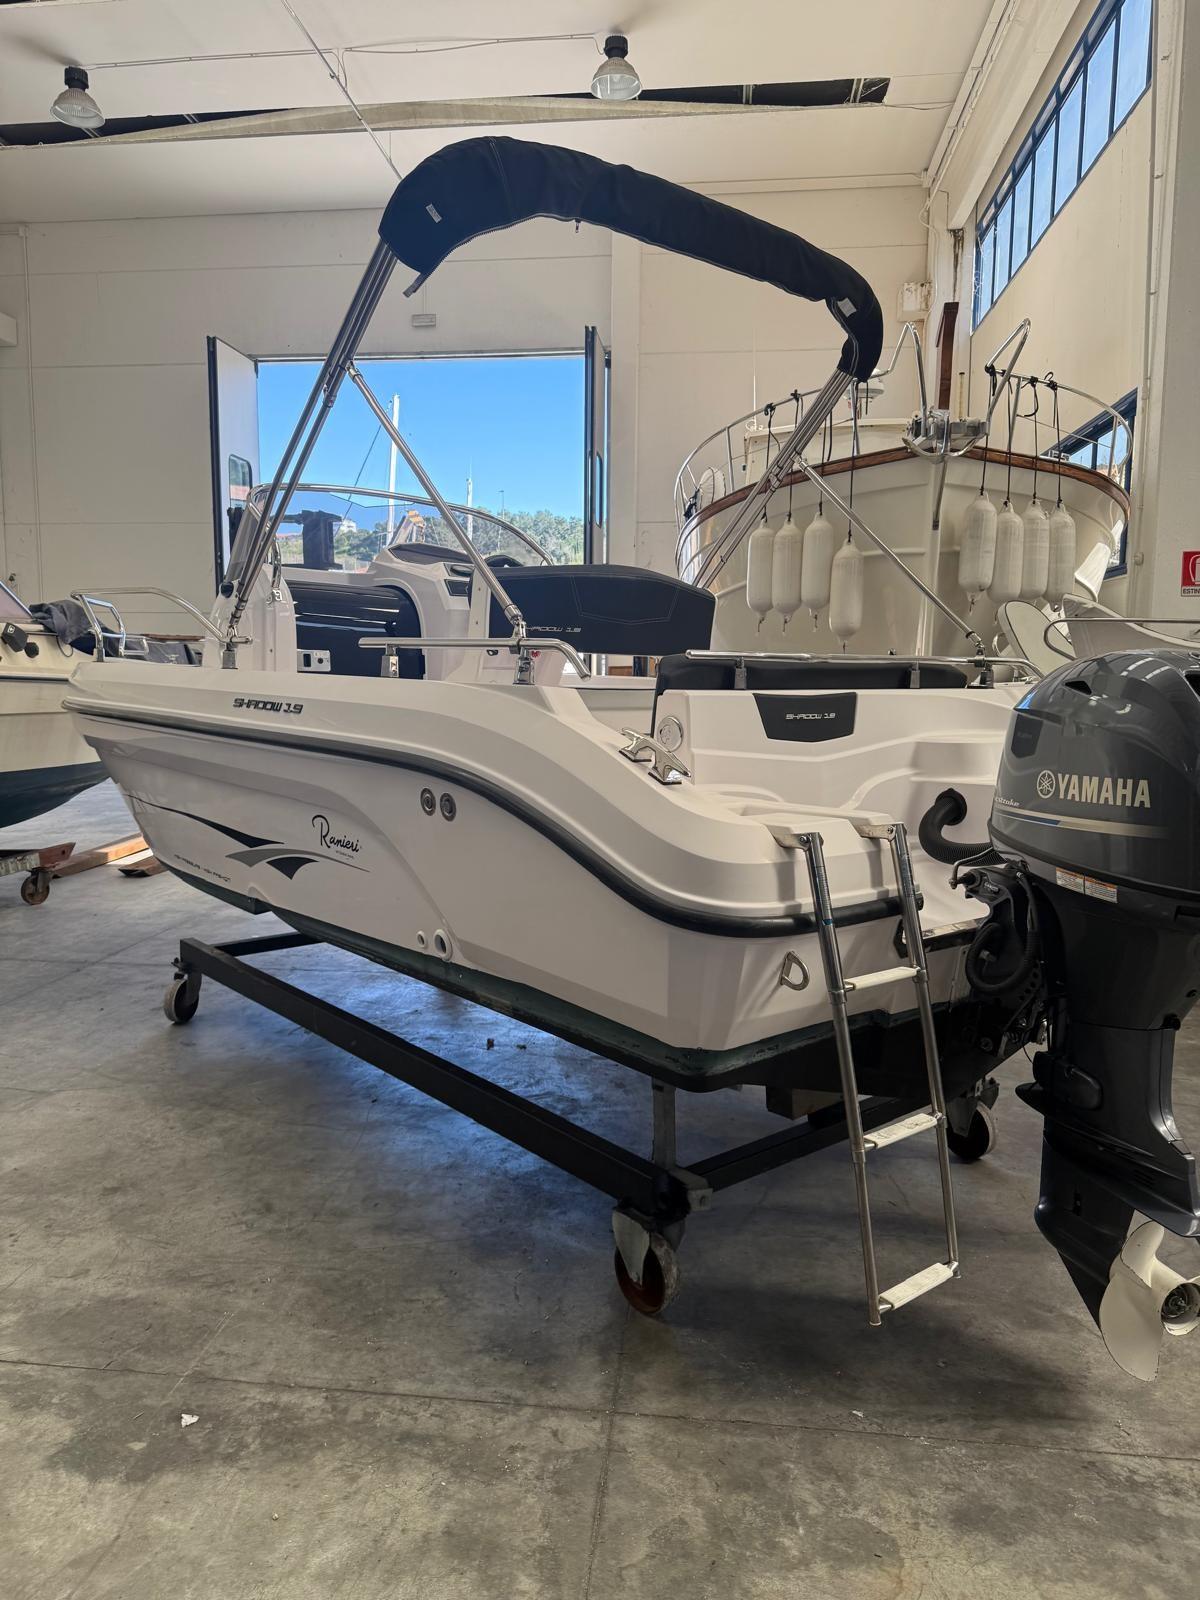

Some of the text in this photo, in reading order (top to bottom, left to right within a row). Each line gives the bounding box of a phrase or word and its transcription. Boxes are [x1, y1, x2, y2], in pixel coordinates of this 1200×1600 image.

[232, 697, 283, 712] SHADOW
[1057, 773, 1151, 808] YAMAHA
[311, 814, 360, 852] Ranieri
